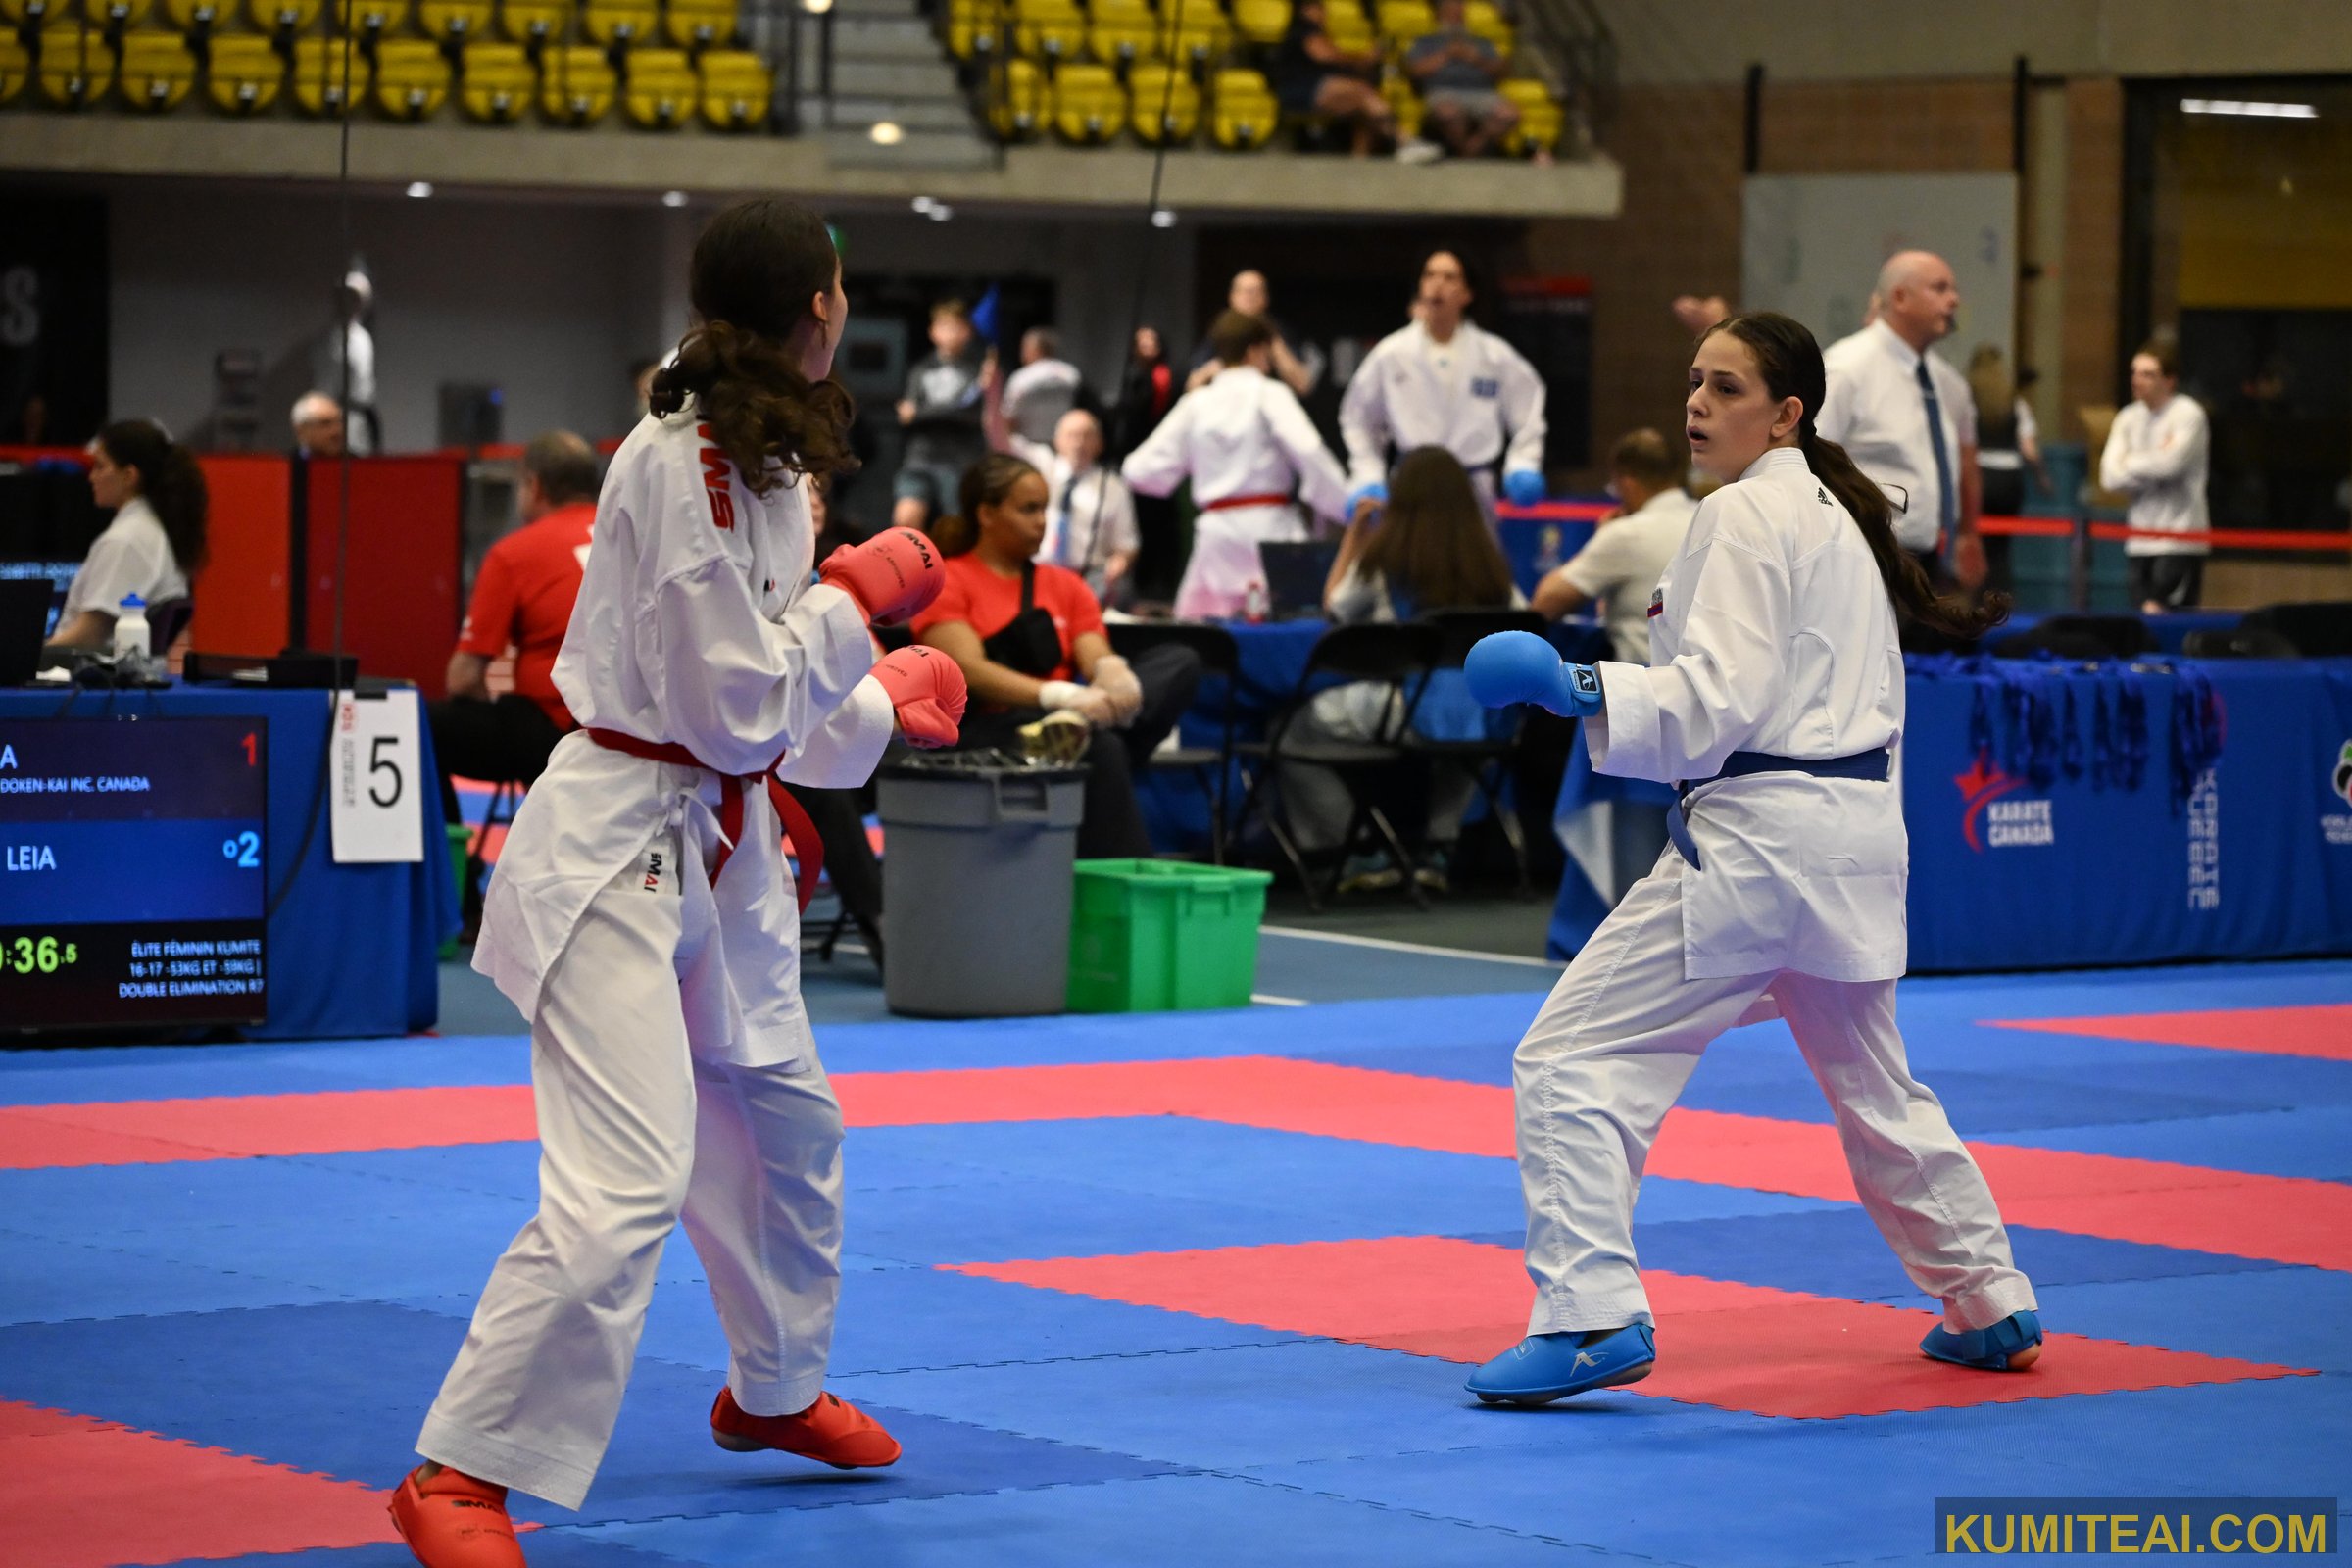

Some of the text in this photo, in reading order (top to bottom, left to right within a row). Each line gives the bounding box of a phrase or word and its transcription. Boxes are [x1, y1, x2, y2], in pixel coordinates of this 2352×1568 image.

[241, 732, 257, 766] 1
[97, 775, 151, 793] CANADA
[368, 736, 403, 808] 5
[7, 845, 57, 871] LEIA
[119, 982, 167, 998] DOUBLE
[169, 980, 245, 996] ELIMINATION
